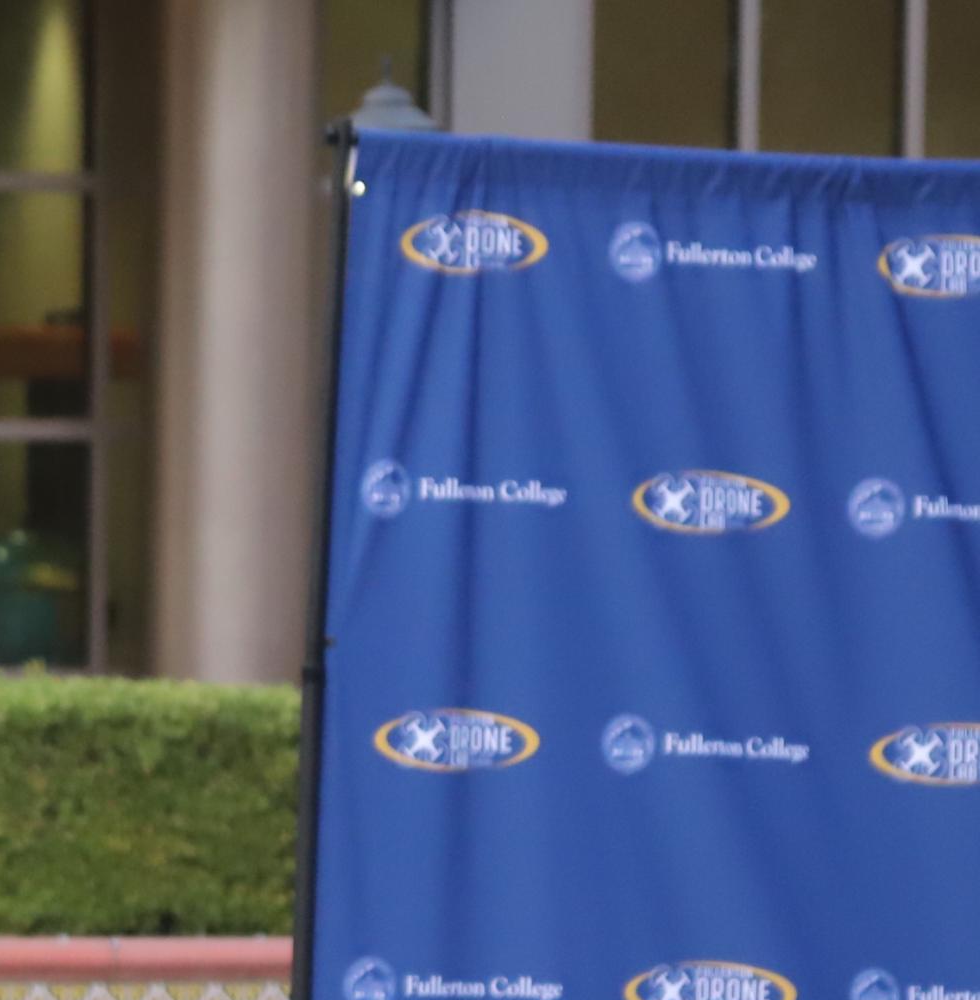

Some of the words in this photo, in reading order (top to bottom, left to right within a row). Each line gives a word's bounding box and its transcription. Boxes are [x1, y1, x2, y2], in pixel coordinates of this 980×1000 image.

[466, 226, 523, 256] DONE
[668, 240, 752, 265] Fullerton
[701, 487, 764, 517] DRONE
[451, 726, 512, 755] DRONE
[404, 975, 485, 998] Fullerton
